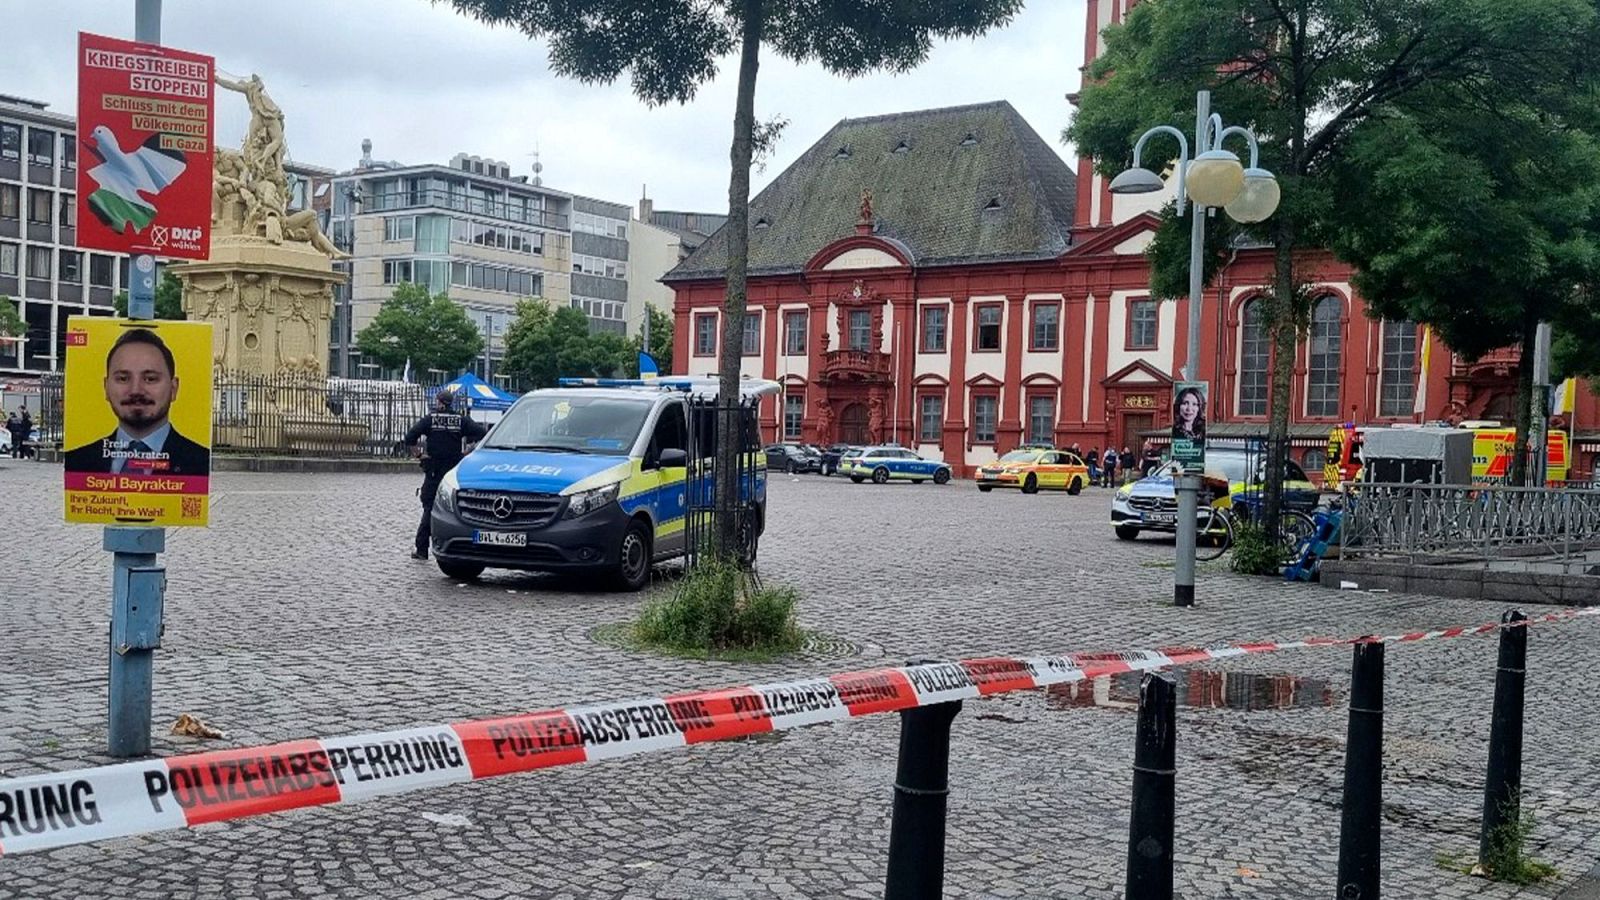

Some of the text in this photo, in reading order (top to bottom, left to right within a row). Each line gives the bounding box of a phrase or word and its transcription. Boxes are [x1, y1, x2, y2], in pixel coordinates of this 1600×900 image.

[88, 52, 205, 77] KRIEGSTREIBER
[132, 76, 205, 97] STOPPEN!
[104, 97, 205, 117] Schluss mit dem
[134, 117, 205, 134] Völkermord
[162, 136, 205, 151] in Gaza
[172, 227, 202, 241] DKP
[74, 335, 85, 344] 18
[103, 438, 130, 449] Freie
[102, 448, 170, 460] Demokraten
[1472, 456, 1488, 464] 112
[480, 463, 562, 476] POLIZEI
[120, 477, 185, 492] Bayraktar
[70, 495, 129, 507] Ihre Zukunft,
[70, 505, 83, 514] Ihr
[85, 506, 115, 516] Recht,
[144, 732, 464, 813] POLIZEIABSPERRUNG
[487, 699, 715, 760] POLIZEIABSPERRUNG
